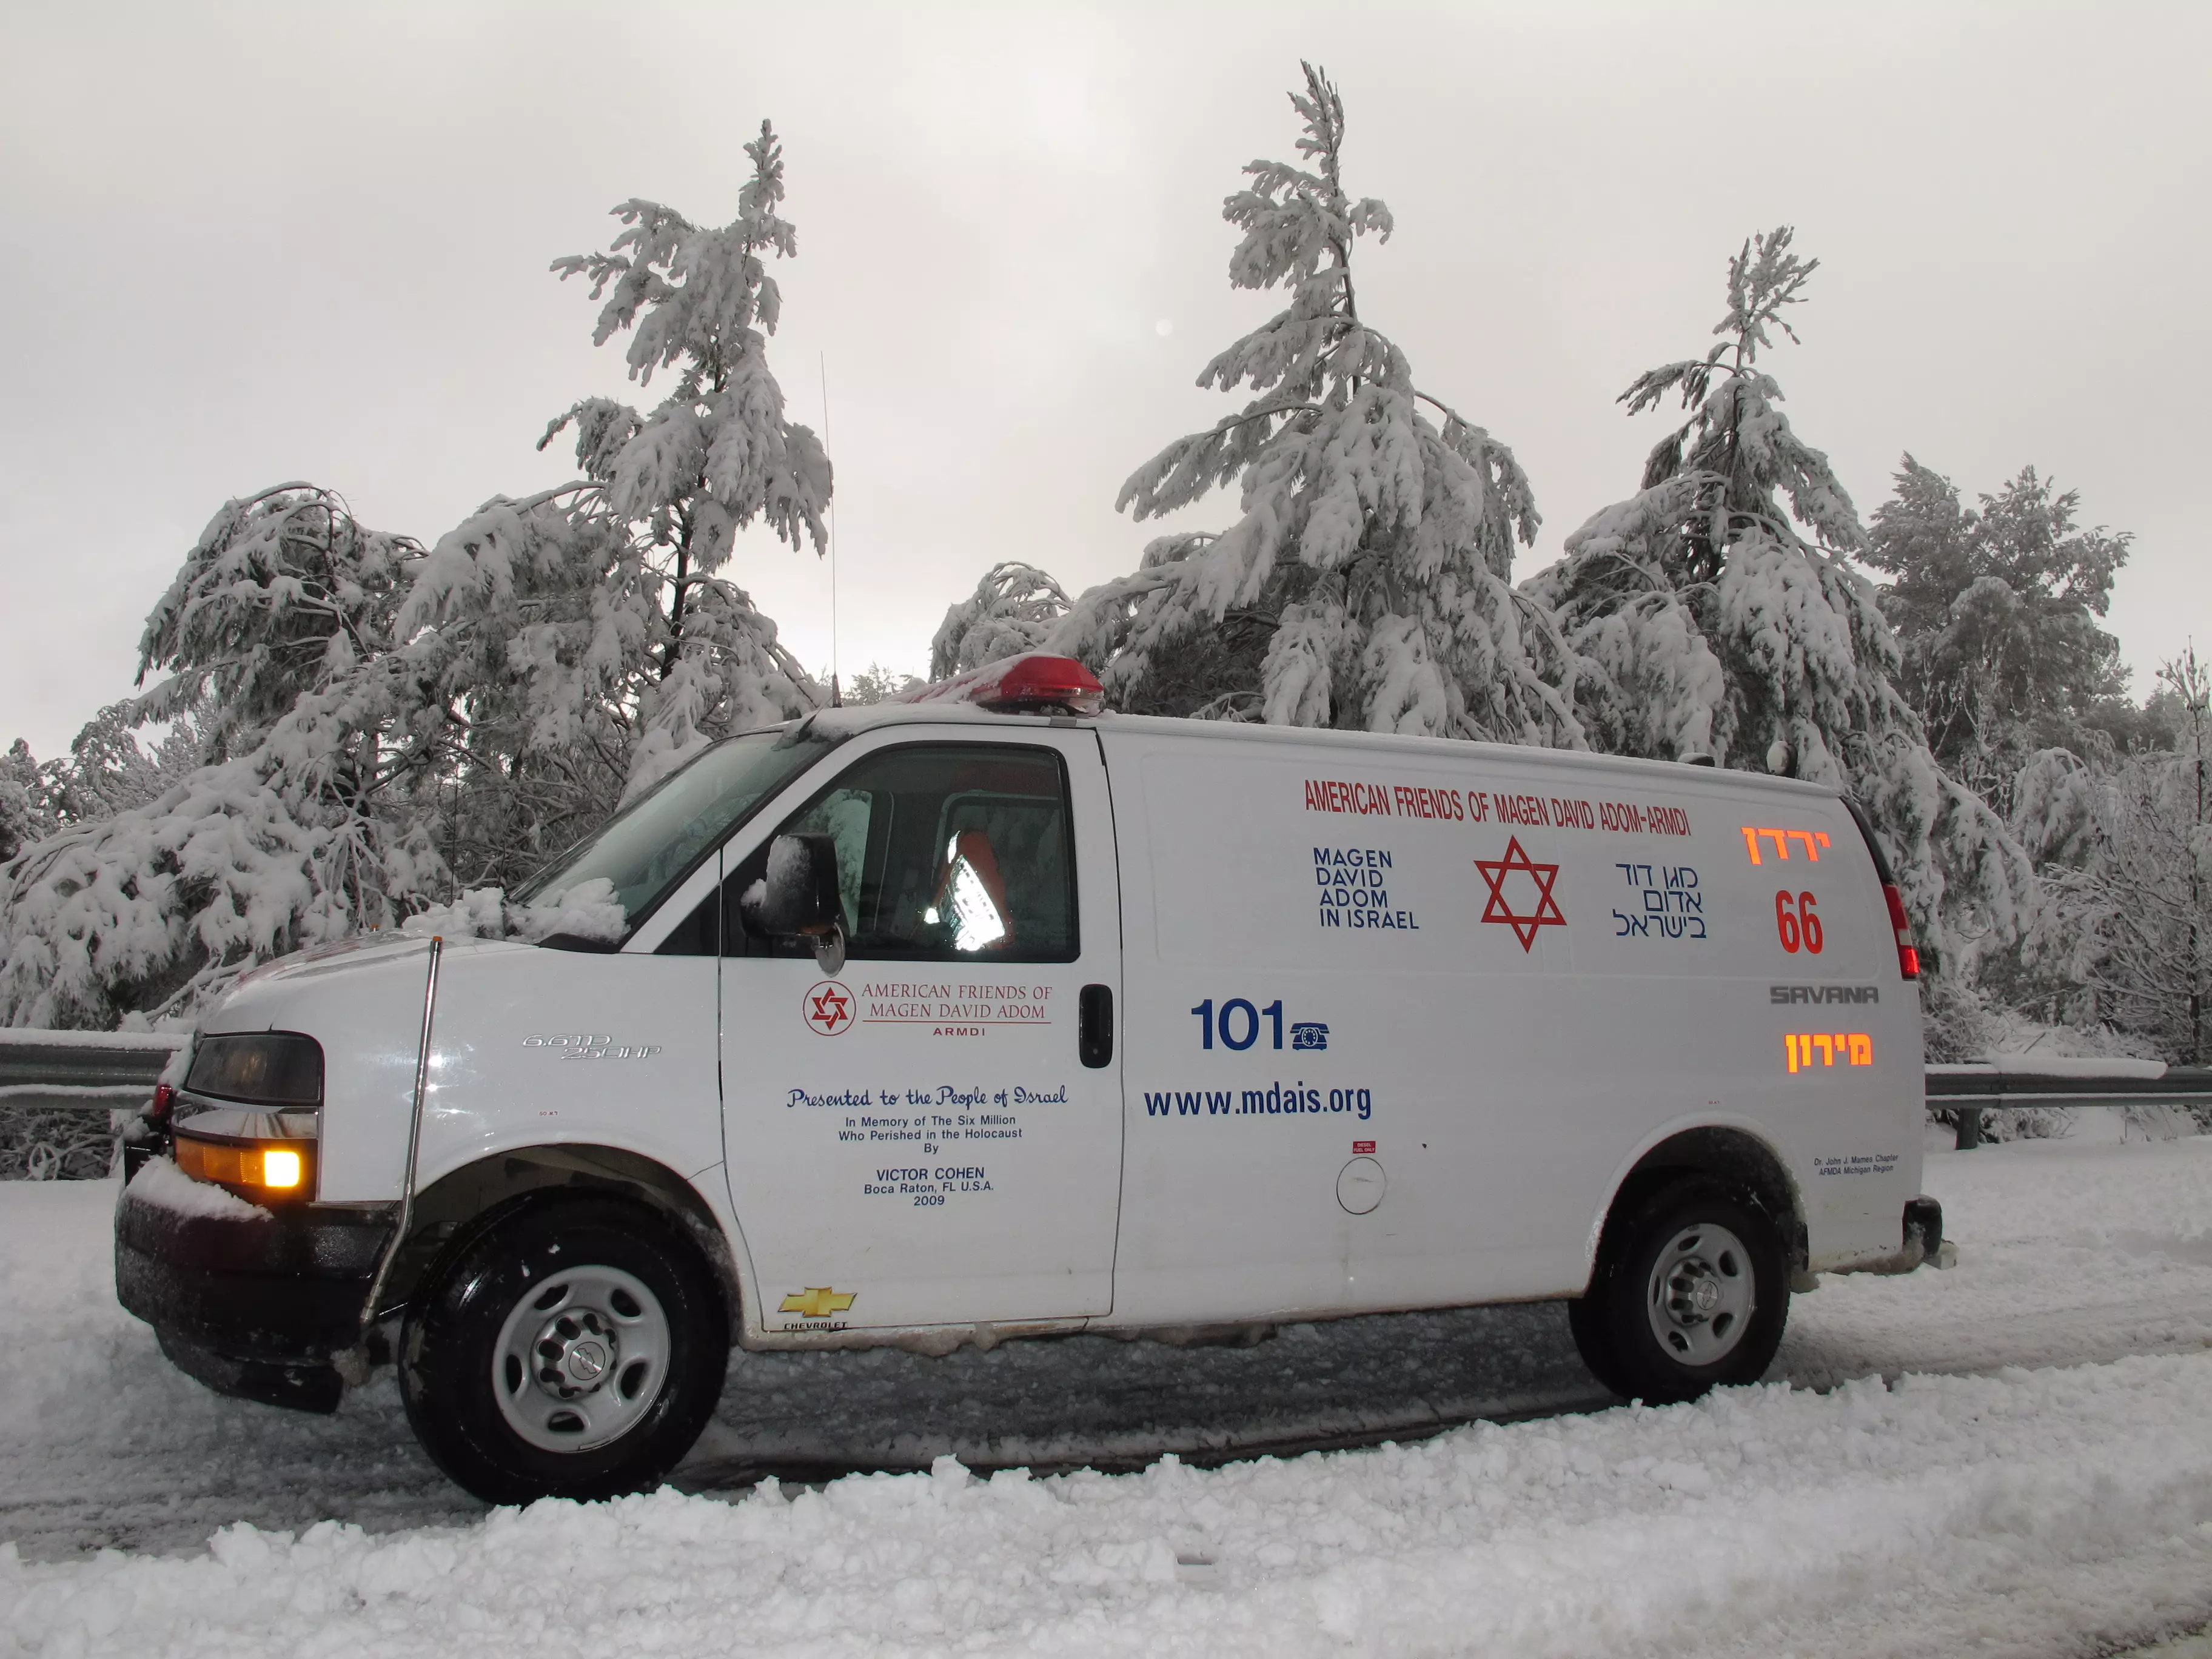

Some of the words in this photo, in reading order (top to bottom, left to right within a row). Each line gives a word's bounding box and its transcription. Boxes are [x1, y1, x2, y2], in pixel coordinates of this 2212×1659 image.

[1305, 780, 1391, 816] AMERICAN
[1393, 786, 1464, 821] FRIENDS
[1467, 791, 1489, 822] OF
[1493, 794, 1550, 826] MAGEN
[1551, 798, 1595, 830] DAVID
[1598, 802, 1691, 836] ADOM-ARMDI
[1741, 826, 1832, 866] ירדן
[1313, 847, 1393, 868] MAGEN
[1315, 866, 1383, 888] DAVID
[1615, 863, 1653, 886] דוד
[1662, 866, 1698, 890] מגן
[1319, 888, 1388, 908] ADOM
[1643, 890, 1704, 914] אדום
[1319, 908, 1341, 927] IN
[1347, 909, 1419, 930] ISRAEL
[1612, 908, 1707, 939] בישראל
[1775, 890, 1823, 954] 66
[861, 983, 951, 999] AMERICAN
[957, 984, 1027, 1000] FRIENDS
[1032, 985, 1053, 1000] OF
[1769, 986, 1879, 1004] SAVANA
[870, 1003, 932, 1017] MAGEN
[938, 1004, 991, 1018] DAVID
[997, 1005, 1046, 1019] ADOM
[933, 1027, 986, 1036] ARMDI
[1191, 998, 1283, 1051] 101
[522, 1034, 612, 1047] 6.6TD
[560, 1046, 662, 1060] 250HP
[1784, 1033, 1874, 1074] מירון
[786, 1088, 873, 1108] Presented
[879, 1090, 900, 1106] to
[905, 1088, 933, 1105] the
[935, 1085, 988, 1111] People
[993, 1088, 1009, 1108] of
[1013, 1084, 1070, 1105] Israel
[1144, 1081, 1372, 1121] www.mdais.org
[845, 1116, 856, 1127] In
[861, 1116, 909, 1130] Memory
[914, 1116, 927, 1127] of
[931, 1115, 953, 1127] The
[957, 1114, 976, 1126] Six
[980, 1114, 1016, 1125] Million
[838, 1130, 865, 1142] Who
[870, 1130, 922, 1141] Perished
[927, 1129, 937, 1140] in
[941, 1128, 960, 1140] the
[965, 1128, 1023, 1139] Holocaust
[923, 1142, 939, 1155] By
[1825, 1157, 1841, 1165] John
[1875, 1153, 1899, 1163] Chapter
[876, 1168, 928, 1182] VICTOR
[934, 1167, 985, 1180] COHEN
[1818, 1167, 1842, 1176] AFMDA
[1843, 1165, 1871, 1175] Michigan
[1872, 1164, 1894, 1173] Region
[864, 1184, 895, 1195] Boca
[900, 1183, 937, 1195] Raton,
[942, 1182, 957, 1193] FL
[961, 1181, 994, 1192] U.S.A.
[913, 1195, 945, 1207] 2009
[784, 1321, 848, 1330] CHEVROLET
